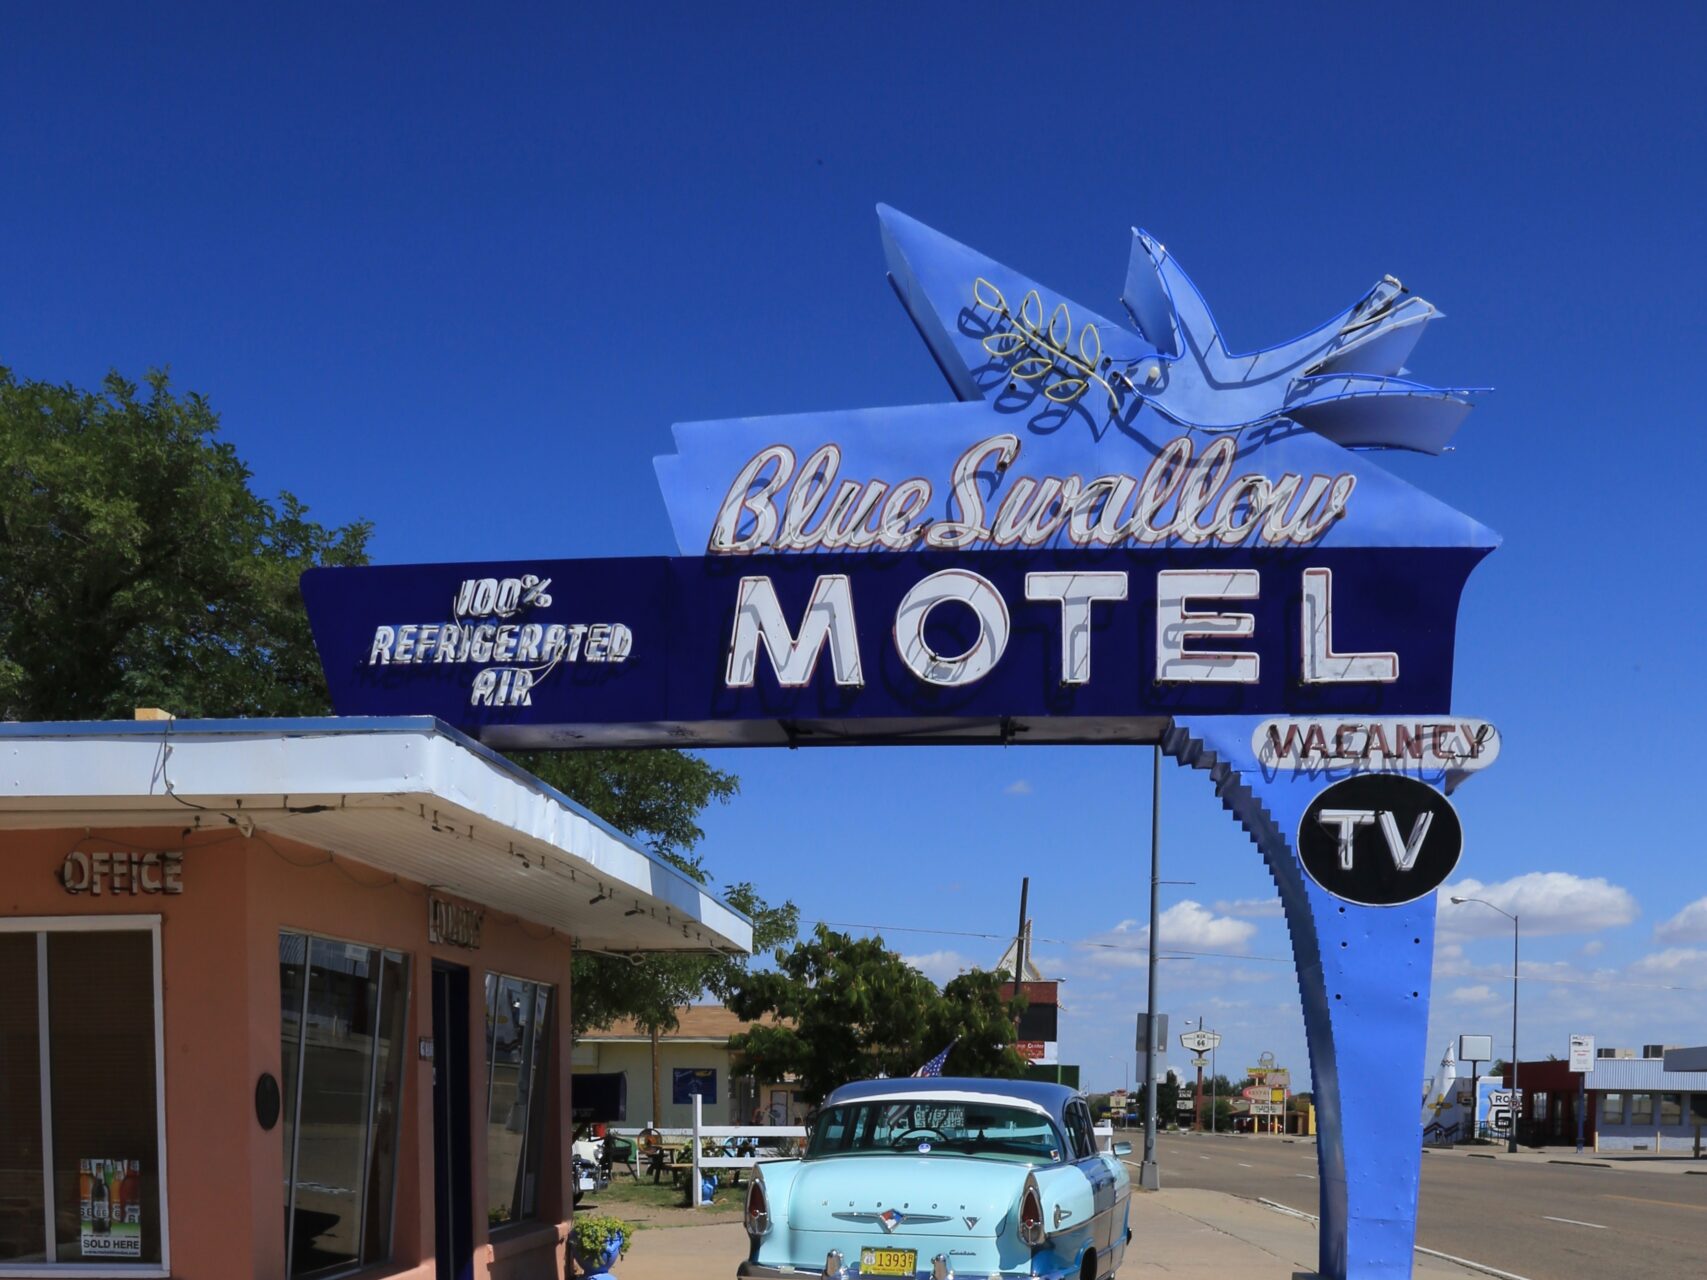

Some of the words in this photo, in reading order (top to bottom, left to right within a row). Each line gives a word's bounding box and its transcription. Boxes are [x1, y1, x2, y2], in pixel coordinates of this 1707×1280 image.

[709, 443, 933, 552] Blue
[923, 434, 1356, 548] Swallow
[455, 574, 553, 618] 100%
[368, 622, 633, 666] REFRIGERATED
[725, 567, 1400, 688] MOTEL
[470, 669, 533, 707] AIR
[1267, 723, 1488, 760] VACANCY
[1317, 809, 1434, 871] TV
[62, 851, 184, 895] OFFICE
[822, 1200, 965, 1210] HUDSON
[83, 1239, 111, 1249] SOLD
[113, 1240, 139, 1250] HERE
[878, 1253, 907, 1268] 1393
